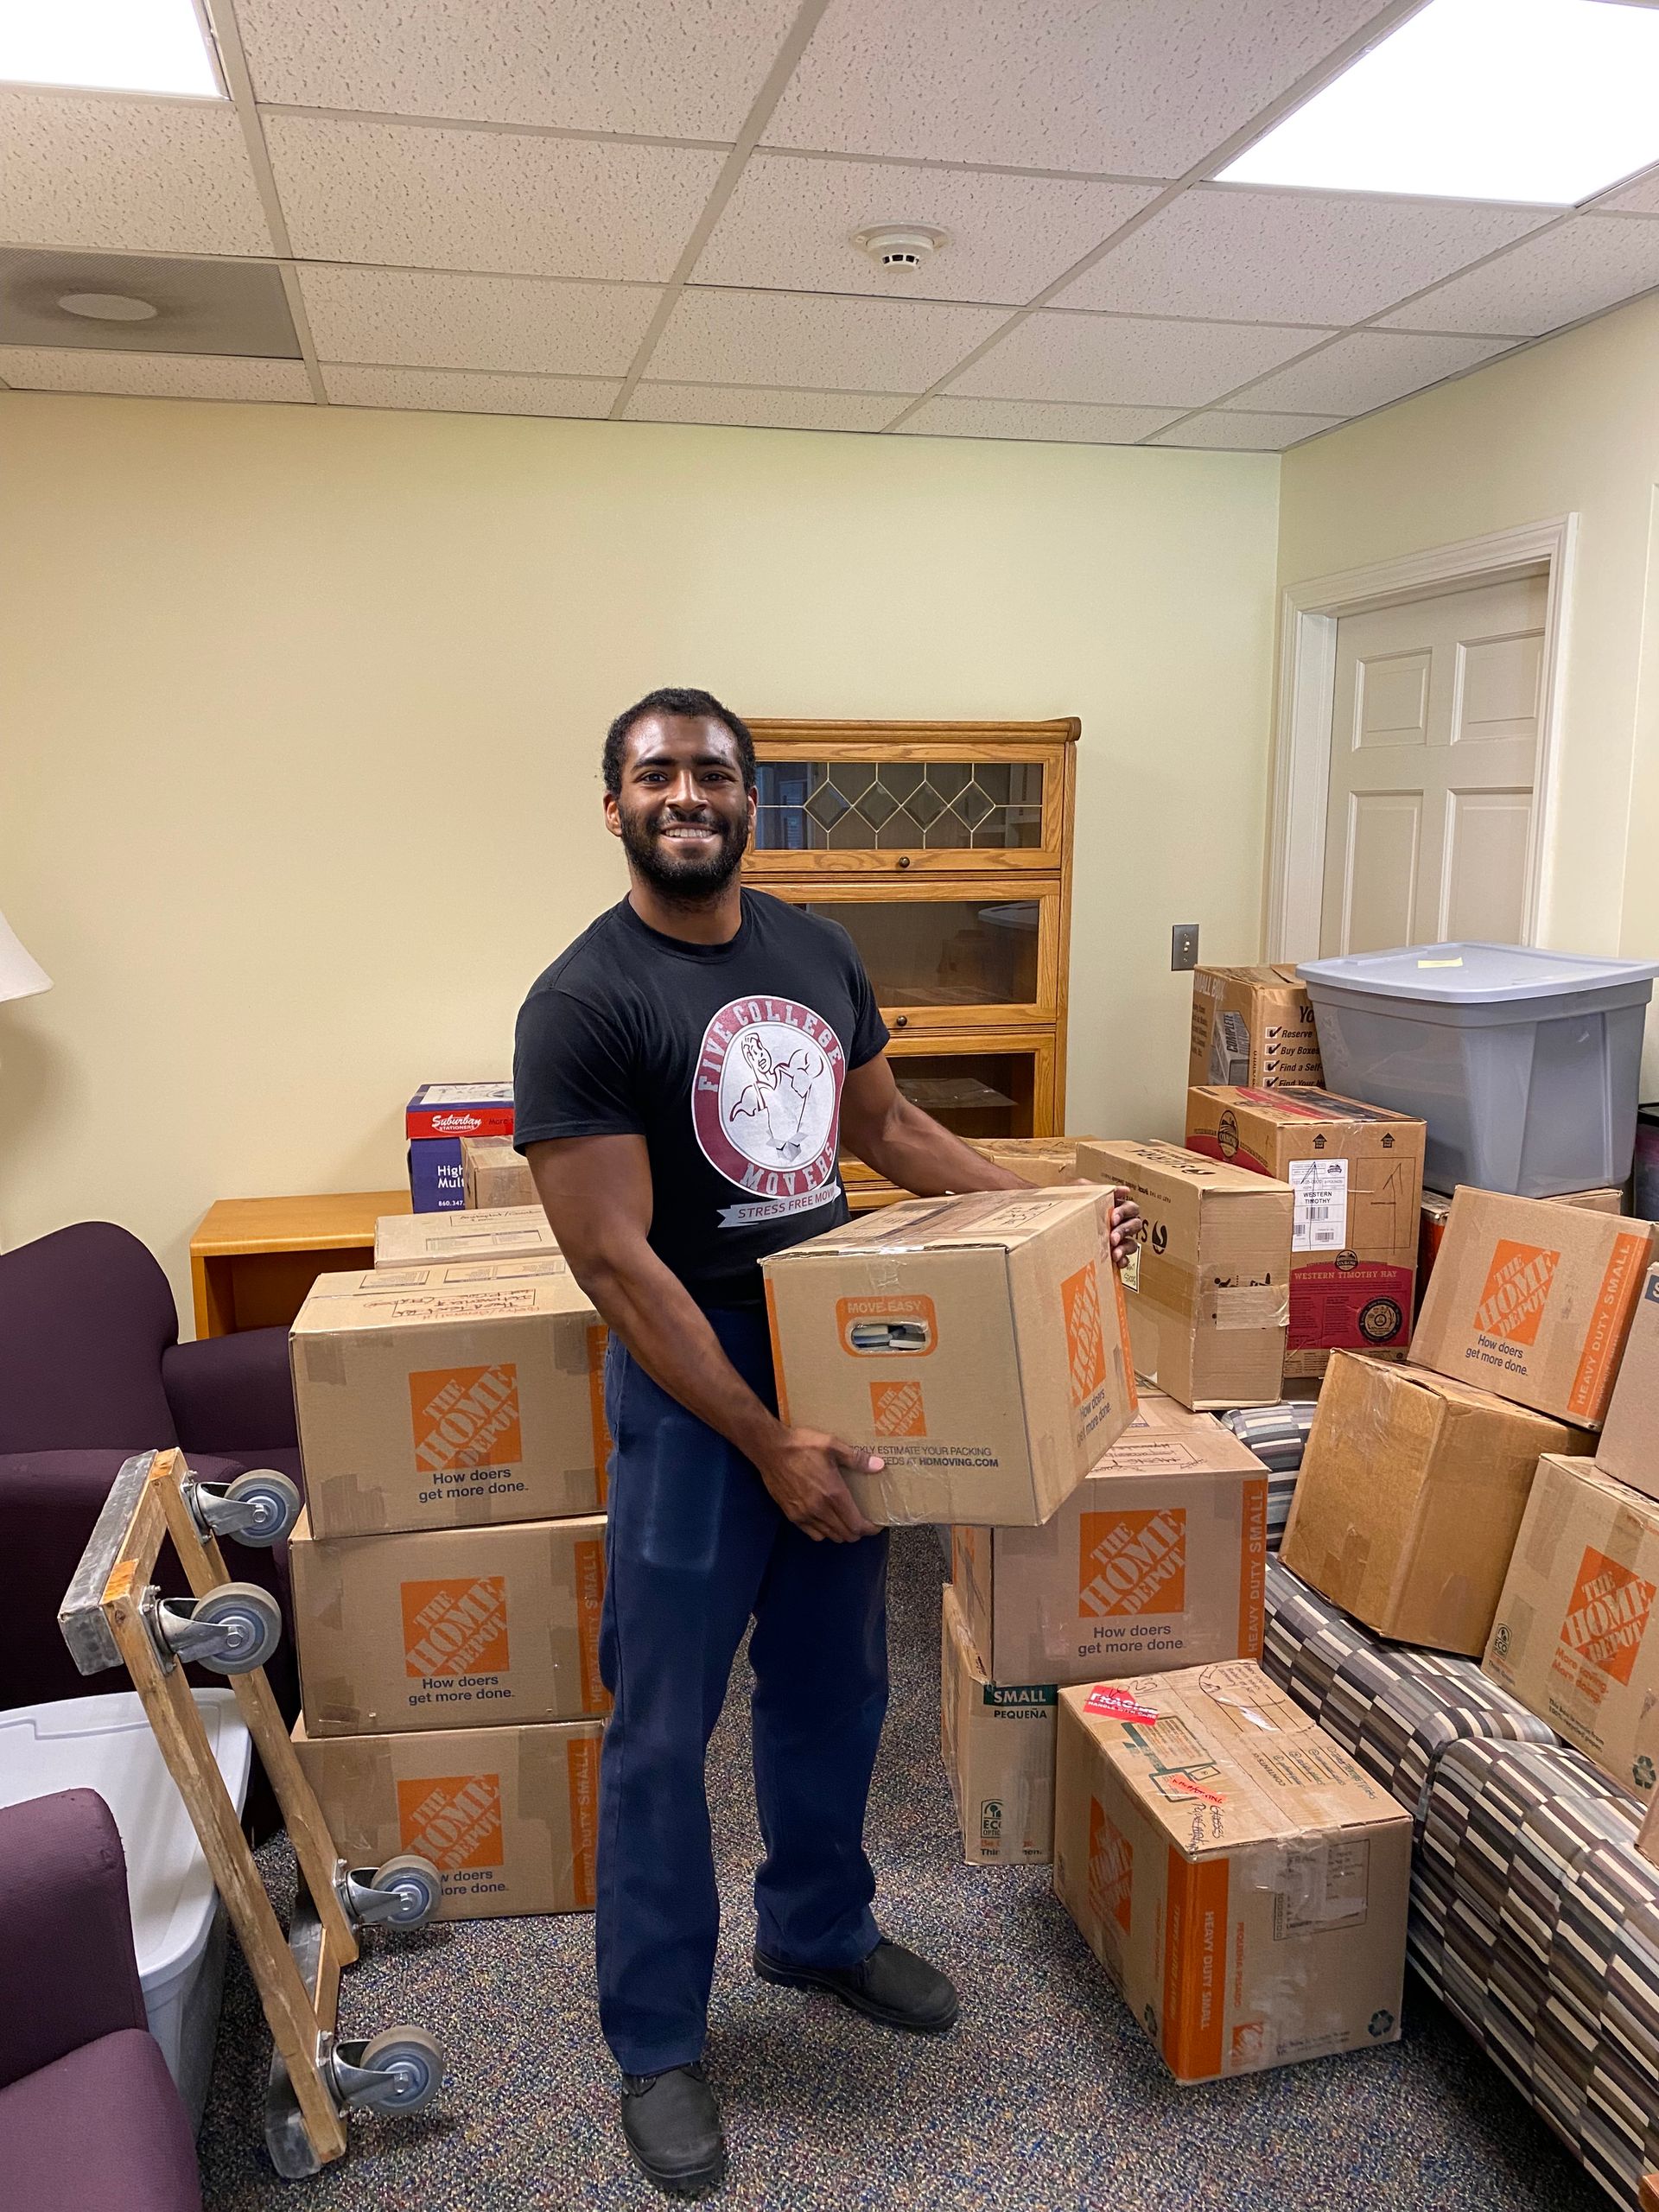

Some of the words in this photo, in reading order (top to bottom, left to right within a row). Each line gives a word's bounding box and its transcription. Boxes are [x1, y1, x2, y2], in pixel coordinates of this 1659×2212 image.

[698, 1022, 731, 1092] FIVE
[733, 1000, 843, 1066] COLLEGE
[1281, 1030, 1313, 1038] Reserve
[1281, 1046, 1295, 1056] Buy
[1297, 1046, 1320, 1055] Boxes
[1279, 1063, 1296, 1071] Find
[432, 1114, 481, 1128] Suburban
[740, 1141, 835, 1195] MOVERS
[738, 1203, 785, 1219] STRESS
[788, 1196, 814, 1211] FREE
[1294, 1271, 1335, 1280] WESTERN
[1338, 1271, 1378, 1279] TIMOTHY
[1493, 1255, 1524, 1285] THE
[1476, 1249, 1558, 1332] HOME
[848, 1302, 885, 1313] MOVE
[888, 1300, 921, 1312] EASY
[1499, 1286, 1549, 1338] DEPOT
[1578, 1356, 1598, 1405] HEAVY
[1592, 1313, 1610, 1352] DUTY
[1605, 1244, 1630, 1305] SMALL
[1465, 1346, 1480, 1360] get
[1481, 1354, 1503, 1367] more
[1504, 1357, 1528, 1376] done.
[1478, 1334, 1498, 1350] How
[1498, 1339, 1523, 1359] doers
[423, 1379, 465, 1419] THE
[876, 1382, 921, 1436] HOME
[415, 1363, 517, 1470] HOME
[458, 1402, 519, 1467] DEPOT
[877, 1446, 920, 1455] ESTIMATE
[922, 1446, 948, 1456] YOUR
[950, 1447, 992, 1456] PACKING
[883, 1456, 905, 1466] EEDS
[906, 1457, 917, 1466] AT
[419, 1489, 443, 1503] get
[446, 1486, 484, 1499] more
[488, 1480, 525, 1494] done.
[433, 1471, 465, 1485] How
[470, 1468, 511, 1481] doers
[1249, 1491, 1263, 1554] SMALL
[1090, 1522, 1136, 1566] THE
[1080, 1509, 1186, 1617] HOME
[584, 1551, 597, 1610] SMALL
[1122, 1548, 1186, 1615] DEPOT
[1249, 1560, 1261, 1600] DUTY
[1581, 1571, 1615, 1602] THE
[413, 1590, 454, 1630] THE
[1563, 1576, 1656, 1648] HOME
[405, 1577, 506, 1677] HOME
[589, 1617, 601, 1652] DUTY
[1093, 1626, 1125, 1639] How
[1130, 1624, 1171, 1637] doers
[1248, 1605, 1260, 1653] HEAVY
[1587, 1621, 1642, 1662] DEPOT
[447, 1612, 508, 1675] DEPOT
[1077, 1643, 1101, 1657] get
[1106, 1641, 1144, 1653] more
[1494, 1639, 1508, 1653] ECO
[1556, 1646, 1578, 1669] More
[422, 1677, 454, 1690] How
[458, 1675, 499, 1687] doers
[1552, 1660, 1574, 1681] More
[409, 1693, 432, 1706] get
[435, 1691, 472, 1702] more
[476, 1686, 513, 1699] done.
[993, 1690, 1046, 1703] SMALL
[994, 1708, 1047, 1719] PEQUEÑA
[575, 1747, 589, 1806] SMALL
[581, 1811, 591, 1848] DUTY
[453, 1870, 493, 1881] doers
[471, 1881, 508, 1894] done.
[1204, 1911, 1214, 1952] HEAVY
[1202, 1956, 1213, 1987] DUTY
[1201, 1991, 1212, 2030] SMALL
